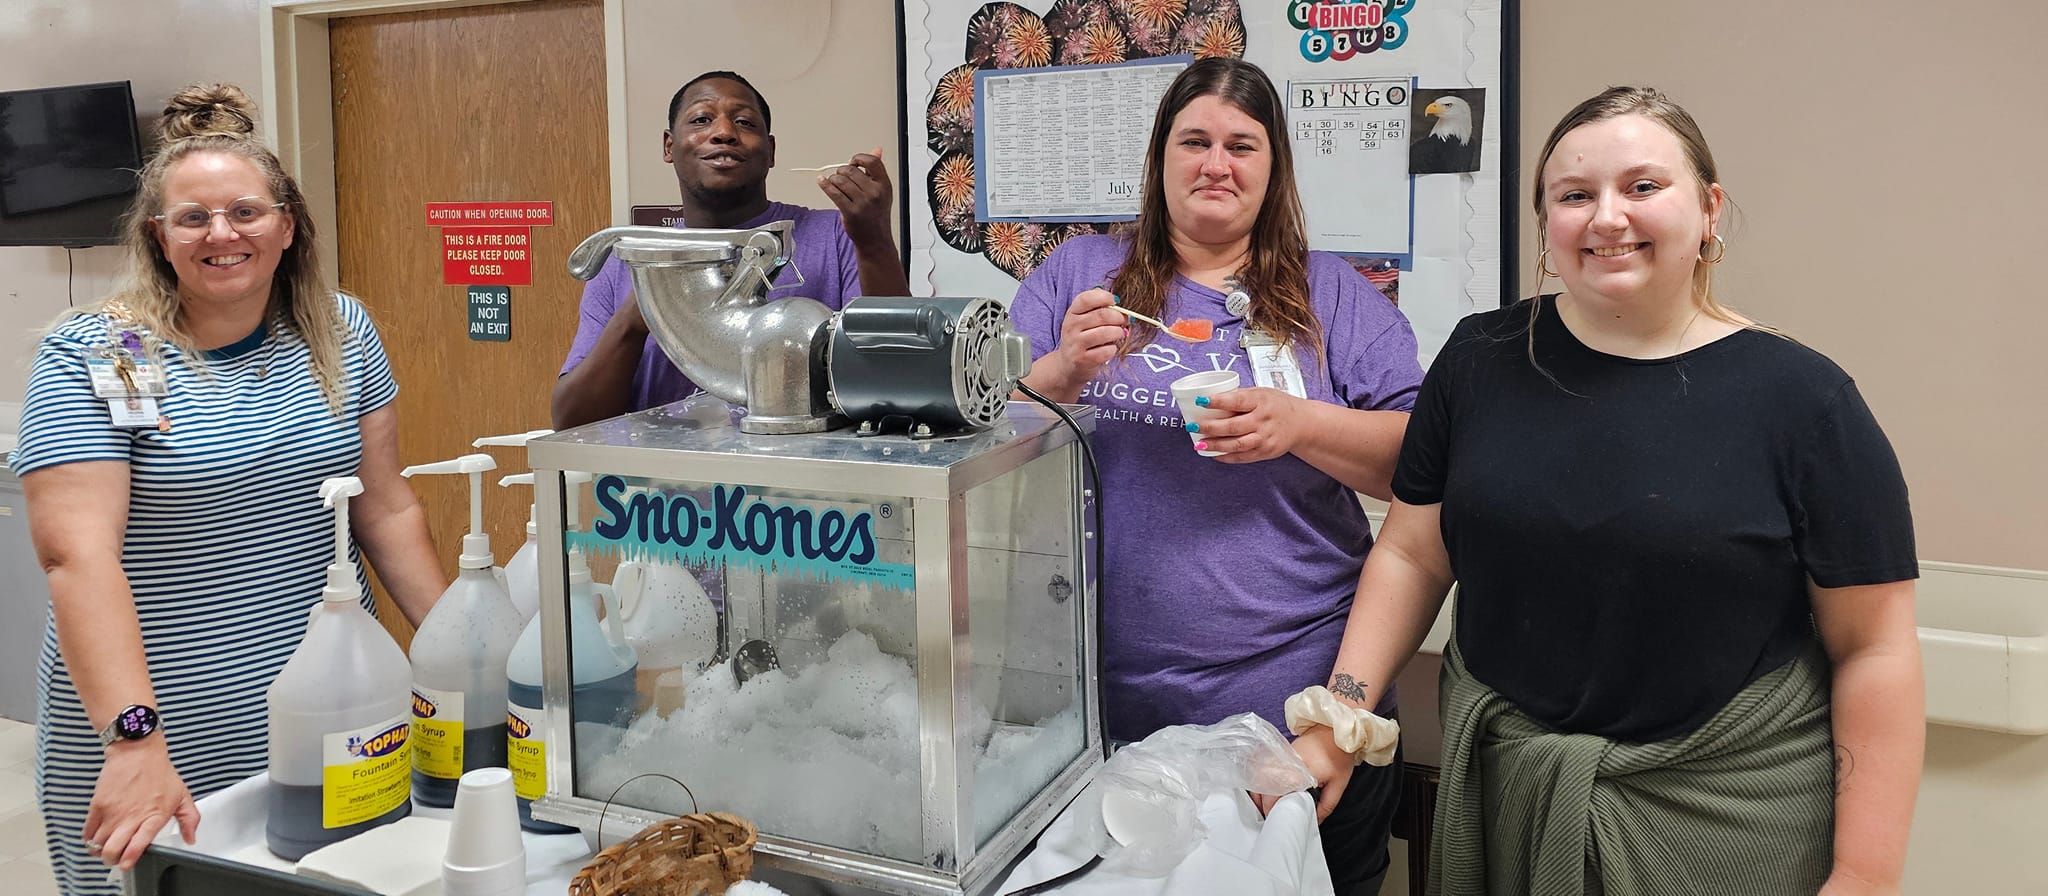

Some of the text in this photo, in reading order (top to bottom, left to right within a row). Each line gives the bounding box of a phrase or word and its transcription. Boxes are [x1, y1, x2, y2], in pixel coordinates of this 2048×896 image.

[1319, 4, 1380, 28] BINGO
[1359, 30, 1374, 43] 17
[1385, 26, 1395, 39] 8
[1312, 39, 1322, 52] 5
[1338, 38, 1347, 50] 7
[1329, 84, 1372, 96] JULY
[1302, 86, 1406, 108] BINGO
[1366, 122, 1378, 130] 54
[1108, 181, 1134, 198] July
[430, 208, 550, 219] CAUTION WHEN OPENING DOOR.
[445, 235, 527, 246] THIS IS A FIRE DOOR
[447, 250, 526, 261] PLEASE KEEP DOOR
[469, 265, 504, 276] CLOSED.
[469, 292, 508, 304] THIS IS
[478, 308, 499, 320] NOT
[470, 323, 508, 335] AN EXIT
[1094, 408, 1139, 422] EALTH
[1144, 414, 1154, 425] &
[421, 723, 446, 738] Syrup
[516, 742, 539, 756] Syrup
[352, 757, 398, 780] Fountain
